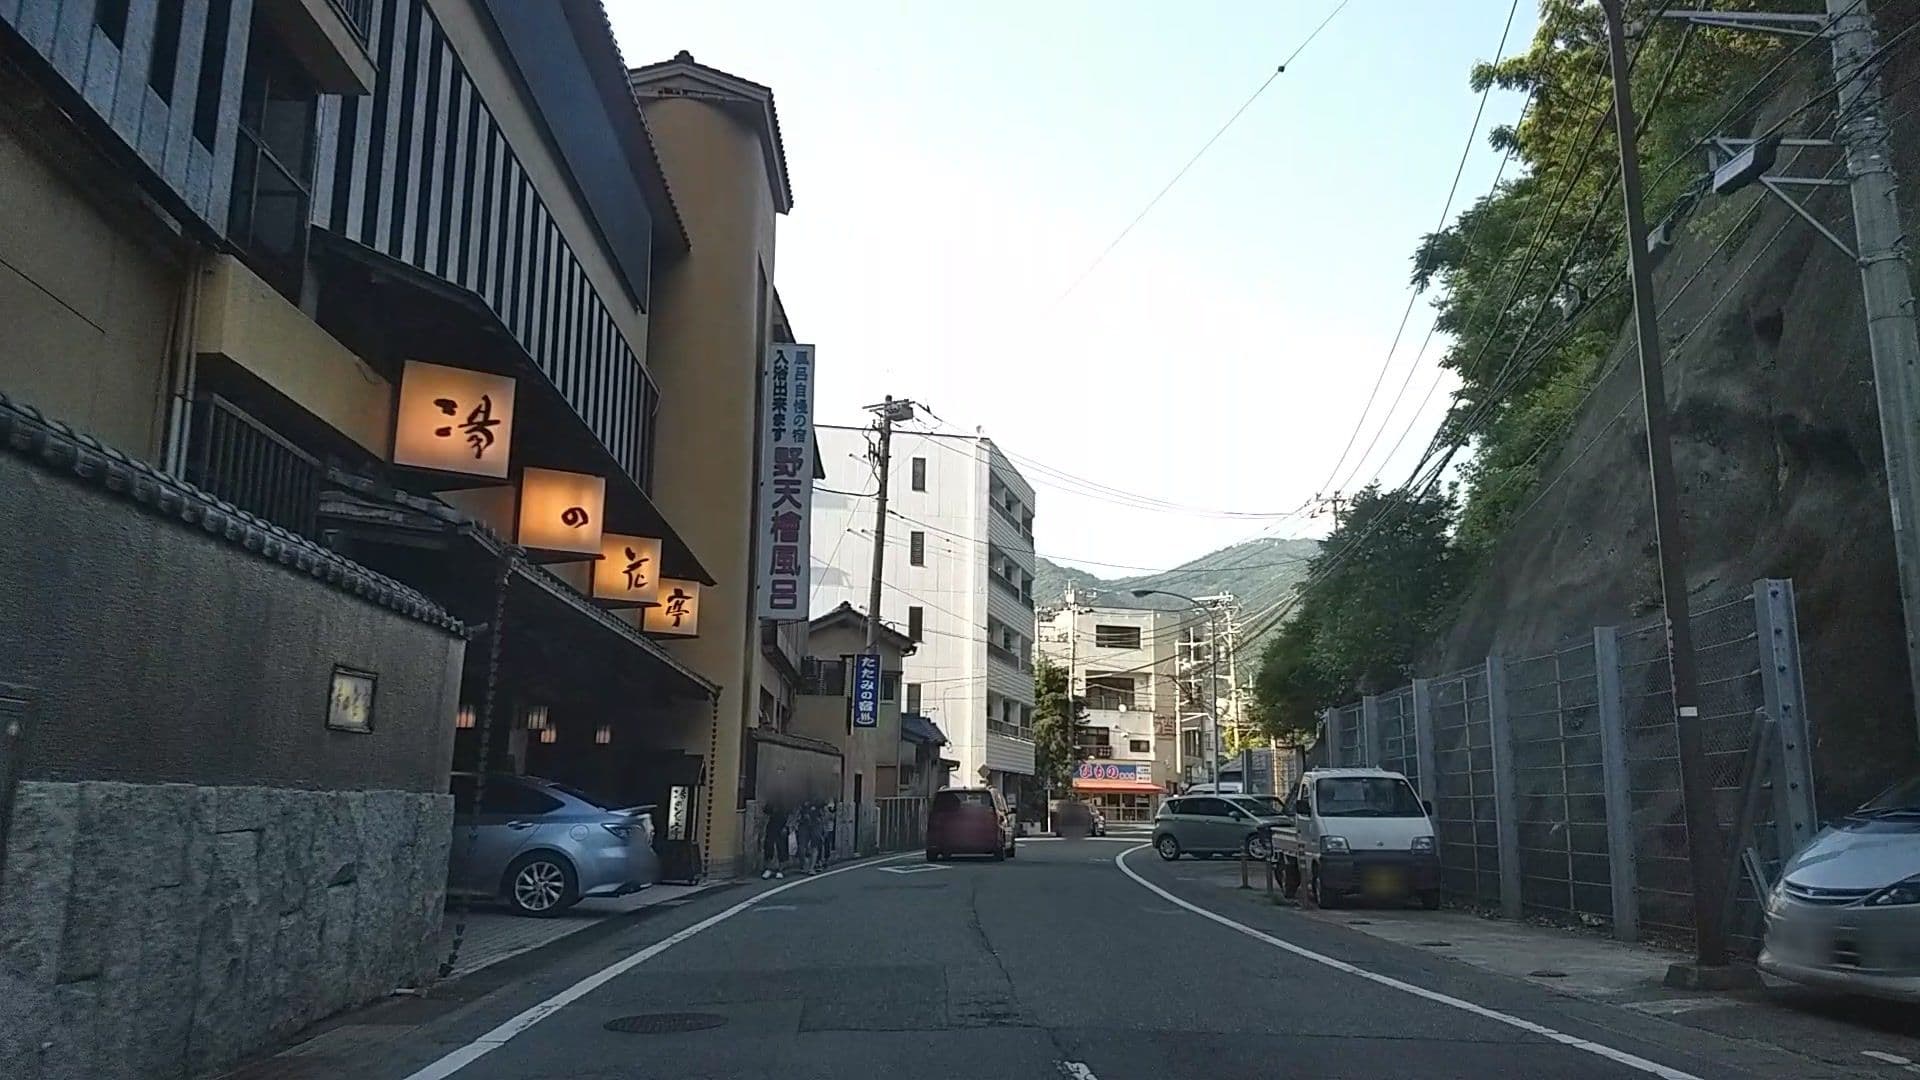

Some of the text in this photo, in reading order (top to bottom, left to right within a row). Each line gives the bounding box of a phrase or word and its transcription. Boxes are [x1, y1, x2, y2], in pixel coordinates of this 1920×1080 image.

[772, 350, 789, 442] 入浴出来ます
[792, 351, 809, 443] 風呂自慢の宿
[858, 657, 875, 712] たたみの宿
